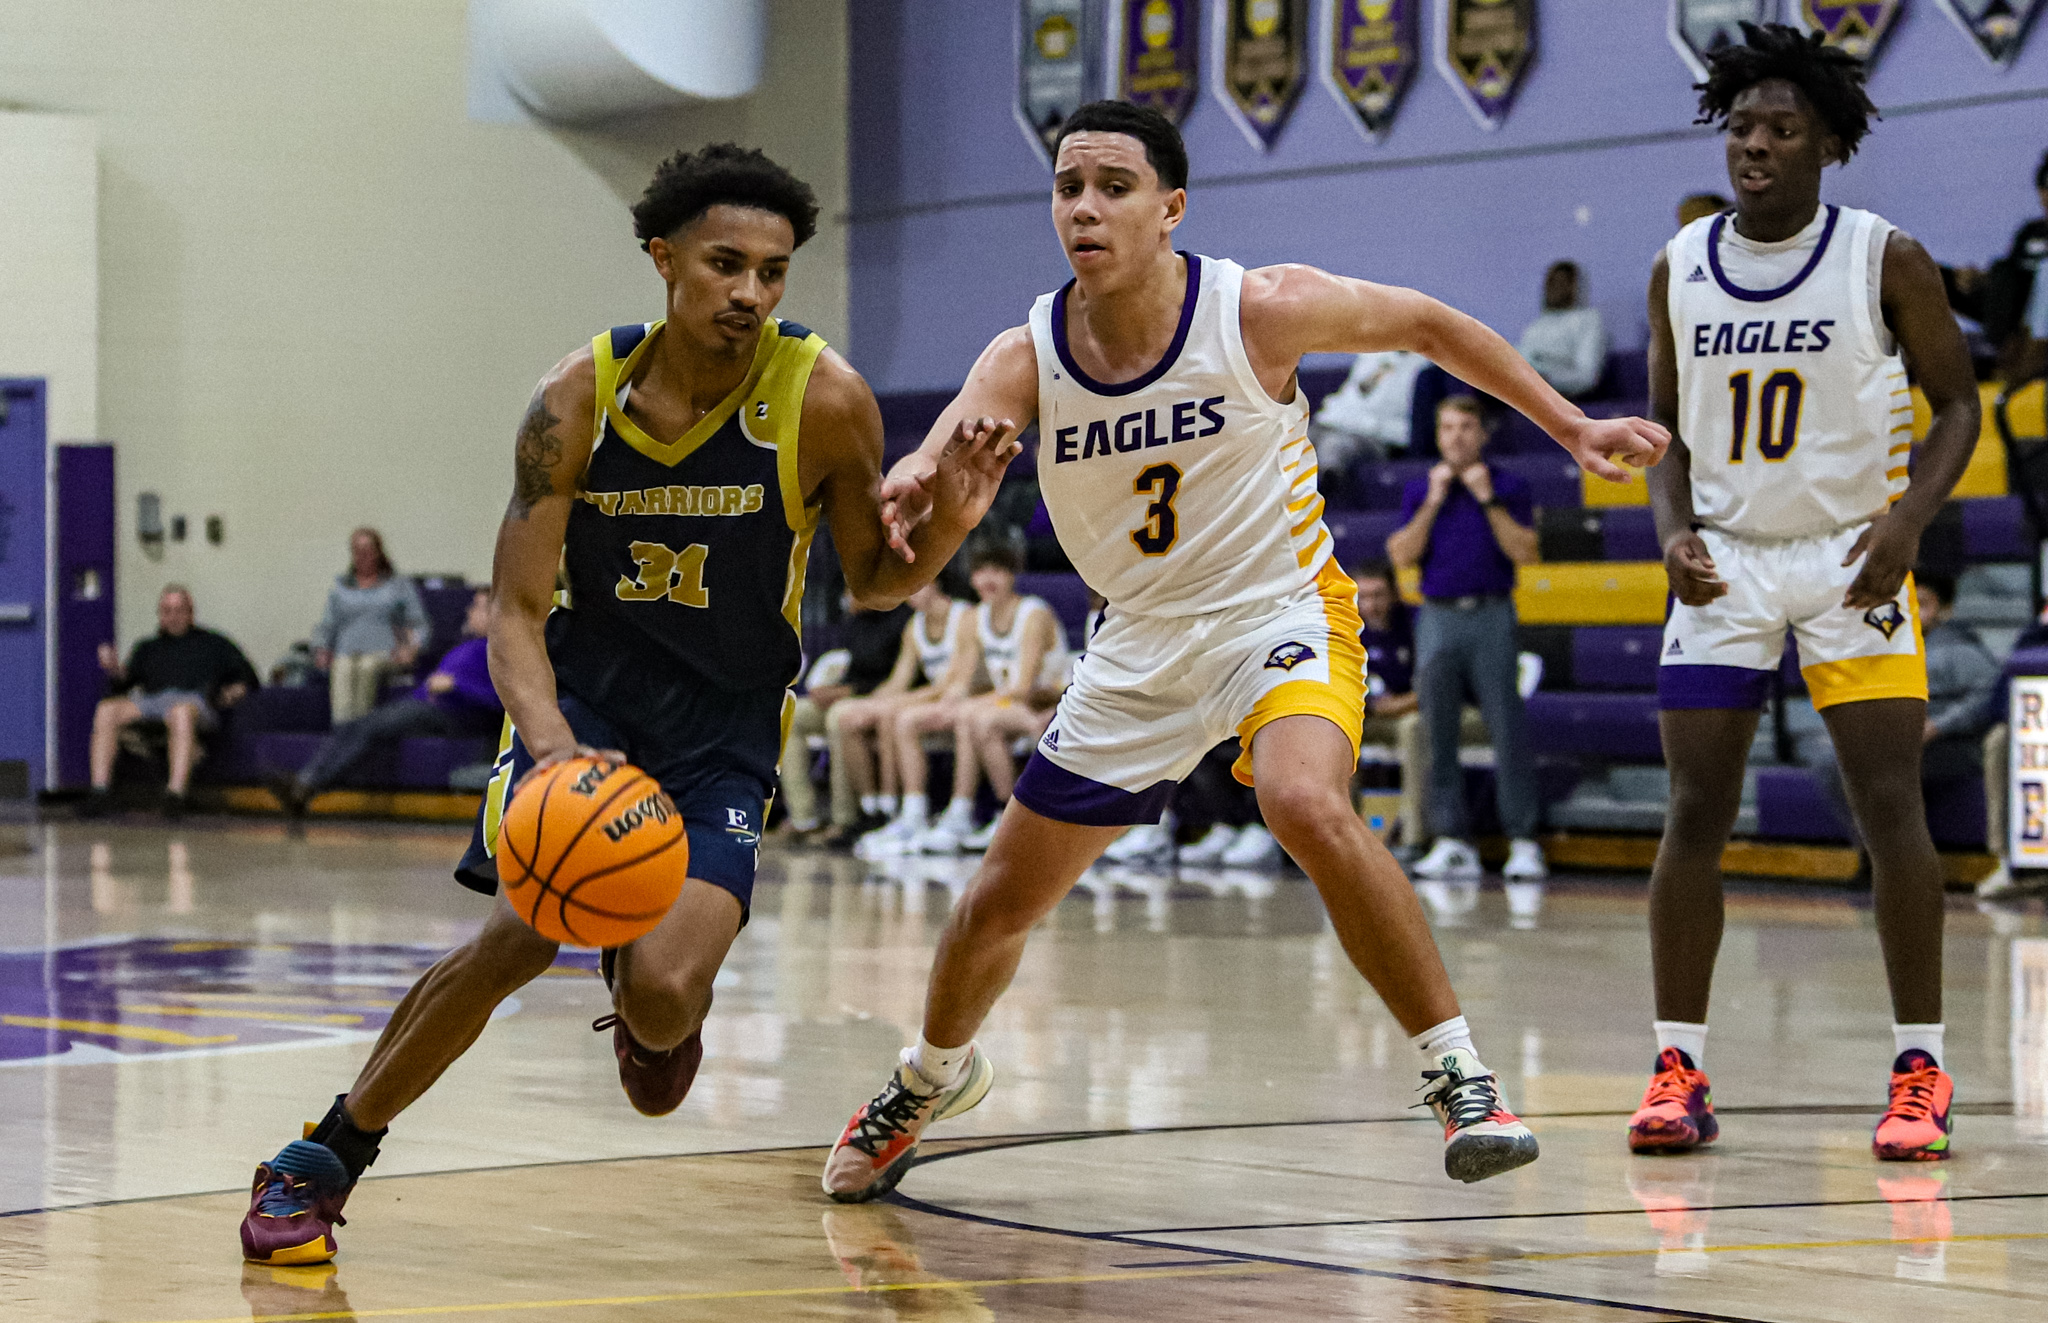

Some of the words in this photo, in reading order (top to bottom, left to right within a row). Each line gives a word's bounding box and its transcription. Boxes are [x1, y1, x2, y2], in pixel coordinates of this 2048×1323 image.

[1694, 320, 1836, 357] EAGLES
[1055, 395, 1225, 464] EAGLES
[1728, 368, 1806, 464] 10
[1129, 460, 1184, 557] 3
[615, 540, 709, 609] 31
